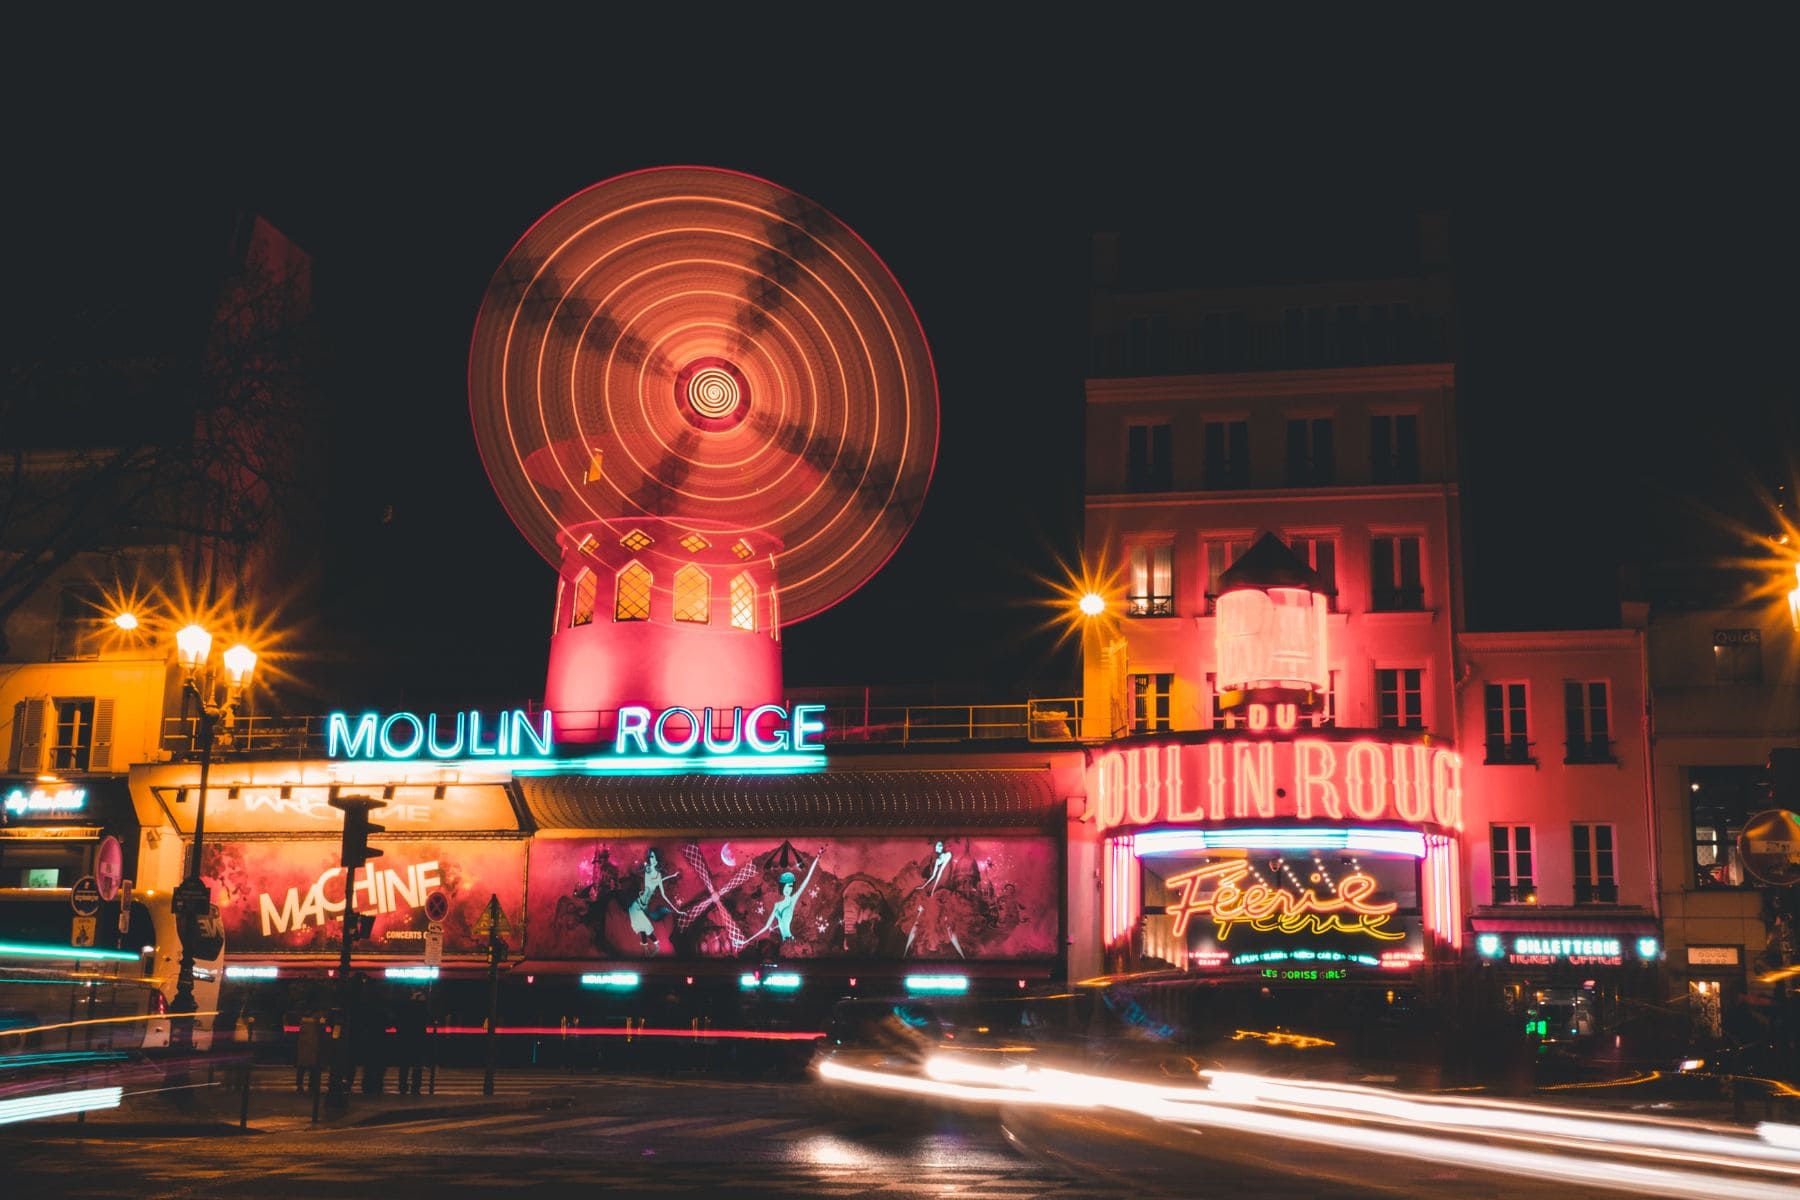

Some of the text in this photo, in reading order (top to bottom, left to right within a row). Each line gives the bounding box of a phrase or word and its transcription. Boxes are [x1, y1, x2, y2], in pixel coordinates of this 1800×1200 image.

[1714, 631, 1760, 644] Quick
[1248, 703, 1297, 730] DU
[328, 704, 826, 758] MOULIN ROUGE
[1097, 740, 1464, 832] OULIN ROUG
[1165, 859, 1398, 937] Féerie
[386, 931, 422, 939] CONCERTS
[1515, 938, 1620, 955] BILLETTERIE
[1510, 954, 1622, 965] TICKET OFFICE
[1261, 969, 1347, 980] LES DORISS GIRLS
